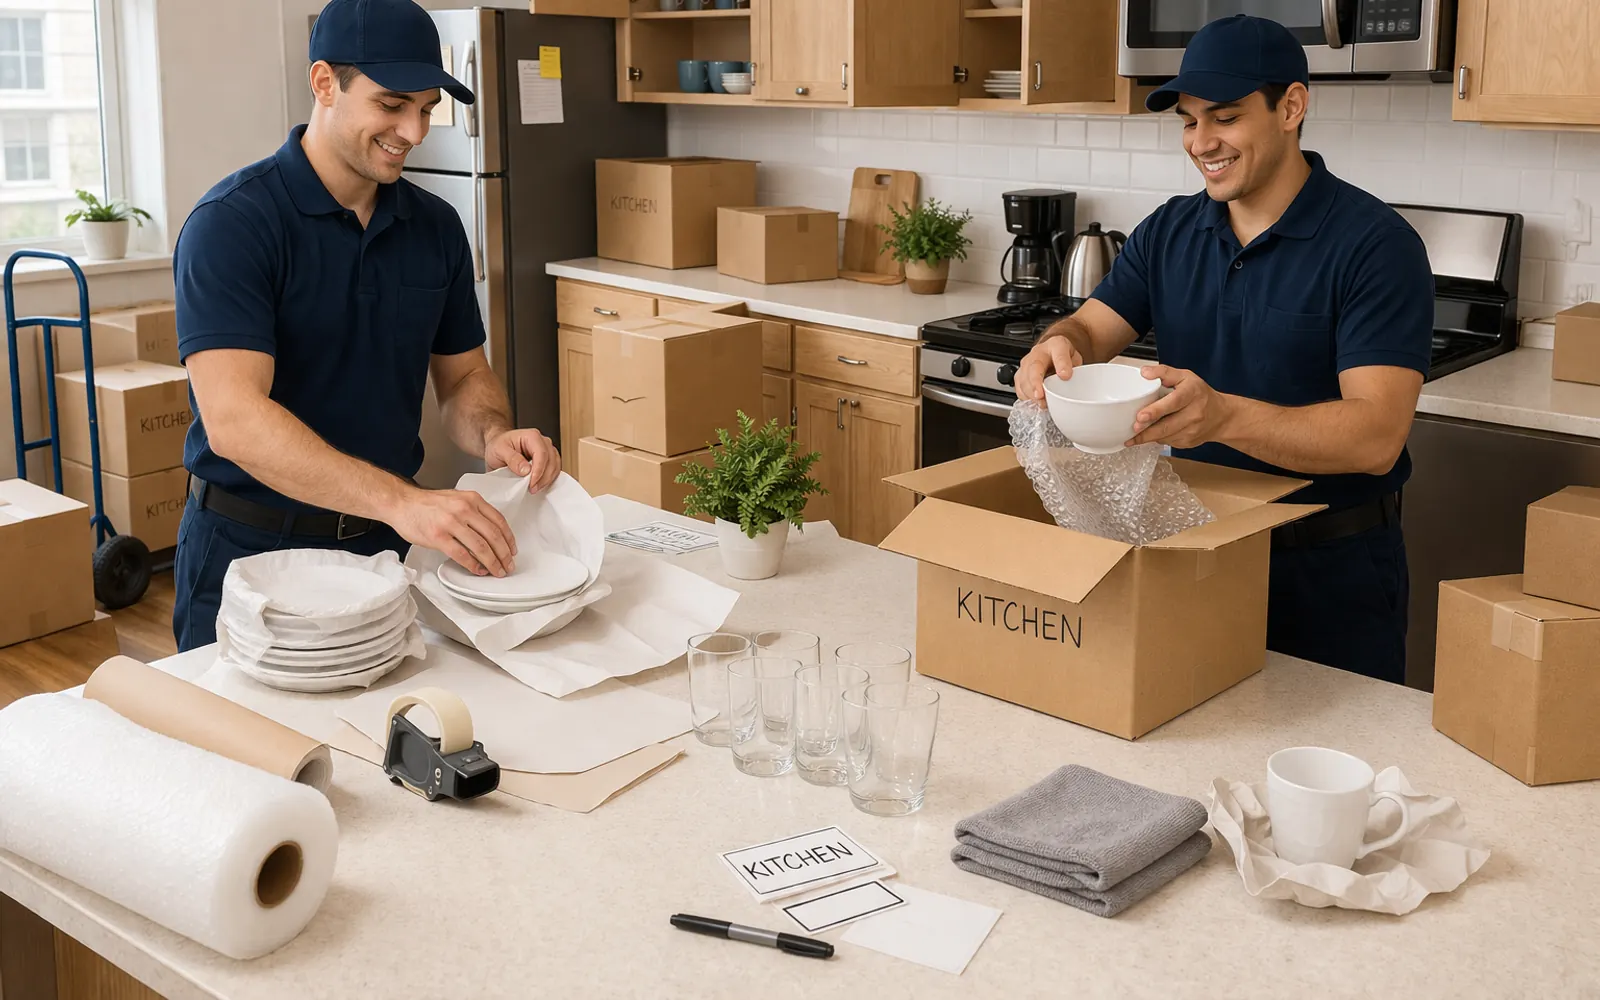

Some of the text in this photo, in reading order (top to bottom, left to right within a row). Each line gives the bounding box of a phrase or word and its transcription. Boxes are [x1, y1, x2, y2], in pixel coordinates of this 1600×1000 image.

[611, 194, 658, 214] KITCHEN
[146, 496, 187, 519] KITCH
[957, 586, 1082, 648] KITCHEN
[742, 841, 853, 880] KITCHEN
